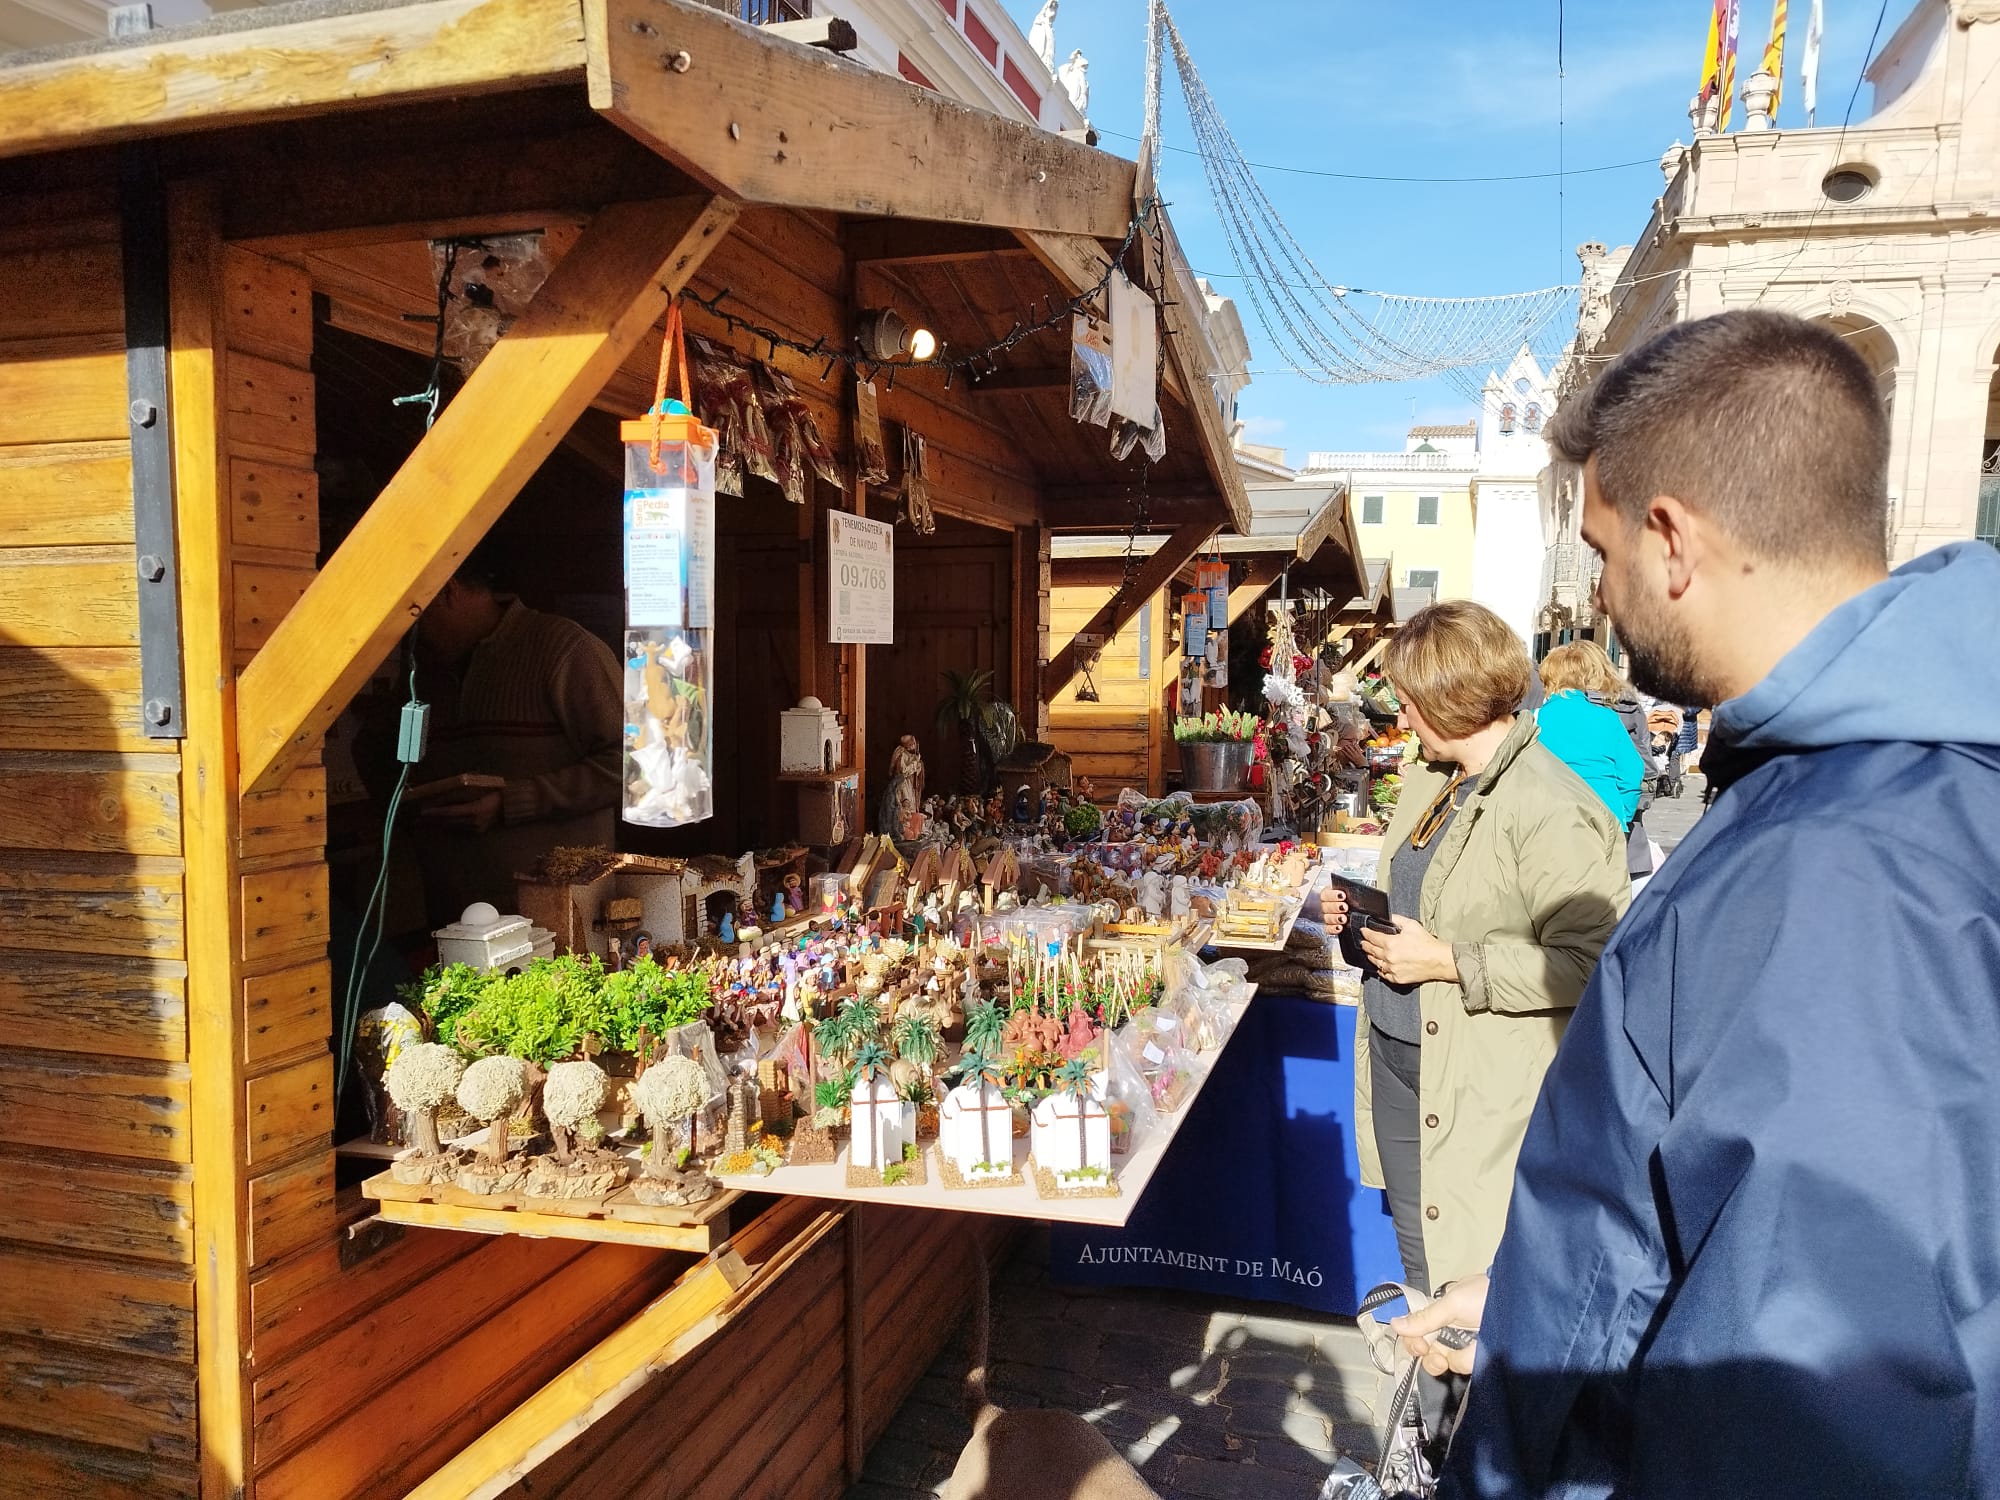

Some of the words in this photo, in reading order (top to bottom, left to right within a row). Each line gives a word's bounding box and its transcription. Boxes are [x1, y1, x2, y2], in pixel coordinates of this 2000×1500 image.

[643, 500, 670, 510] Pedia
[841, 517, 864, 532] TENEMOS
[849, 536, 857, 547] DE
[857, 538, 878, 552] NAVIDAD
[840, 563, 887, 591] 09.768
